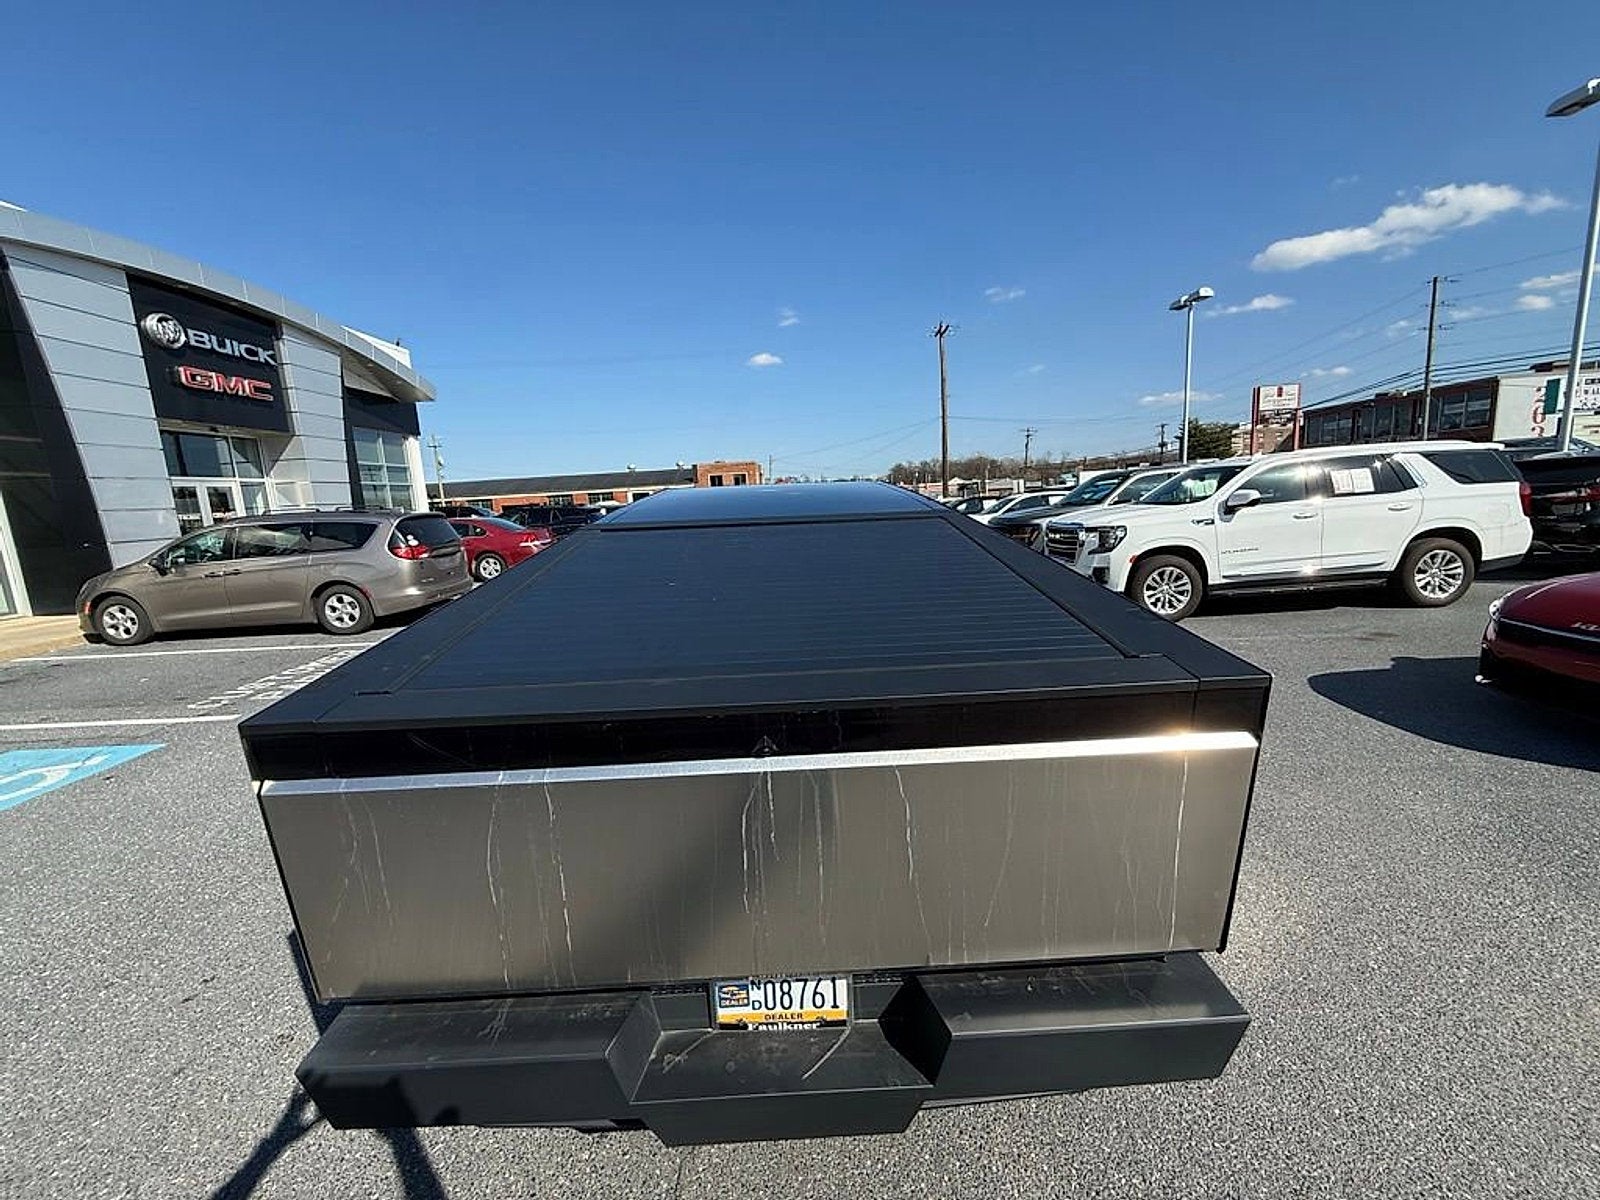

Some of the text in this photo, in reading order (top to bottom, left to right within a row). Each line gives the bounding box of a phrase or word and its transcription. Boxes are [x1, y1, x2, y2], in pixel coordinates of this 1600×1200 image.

[186, 328, 278, 367] BUICK
[177, 365, 274, 402] GMC
[763, 976, 840, 1011] 08761
[748, 1022, 820, 1031] Faulkner
[764, 1013, 804, 1021] DEALER
